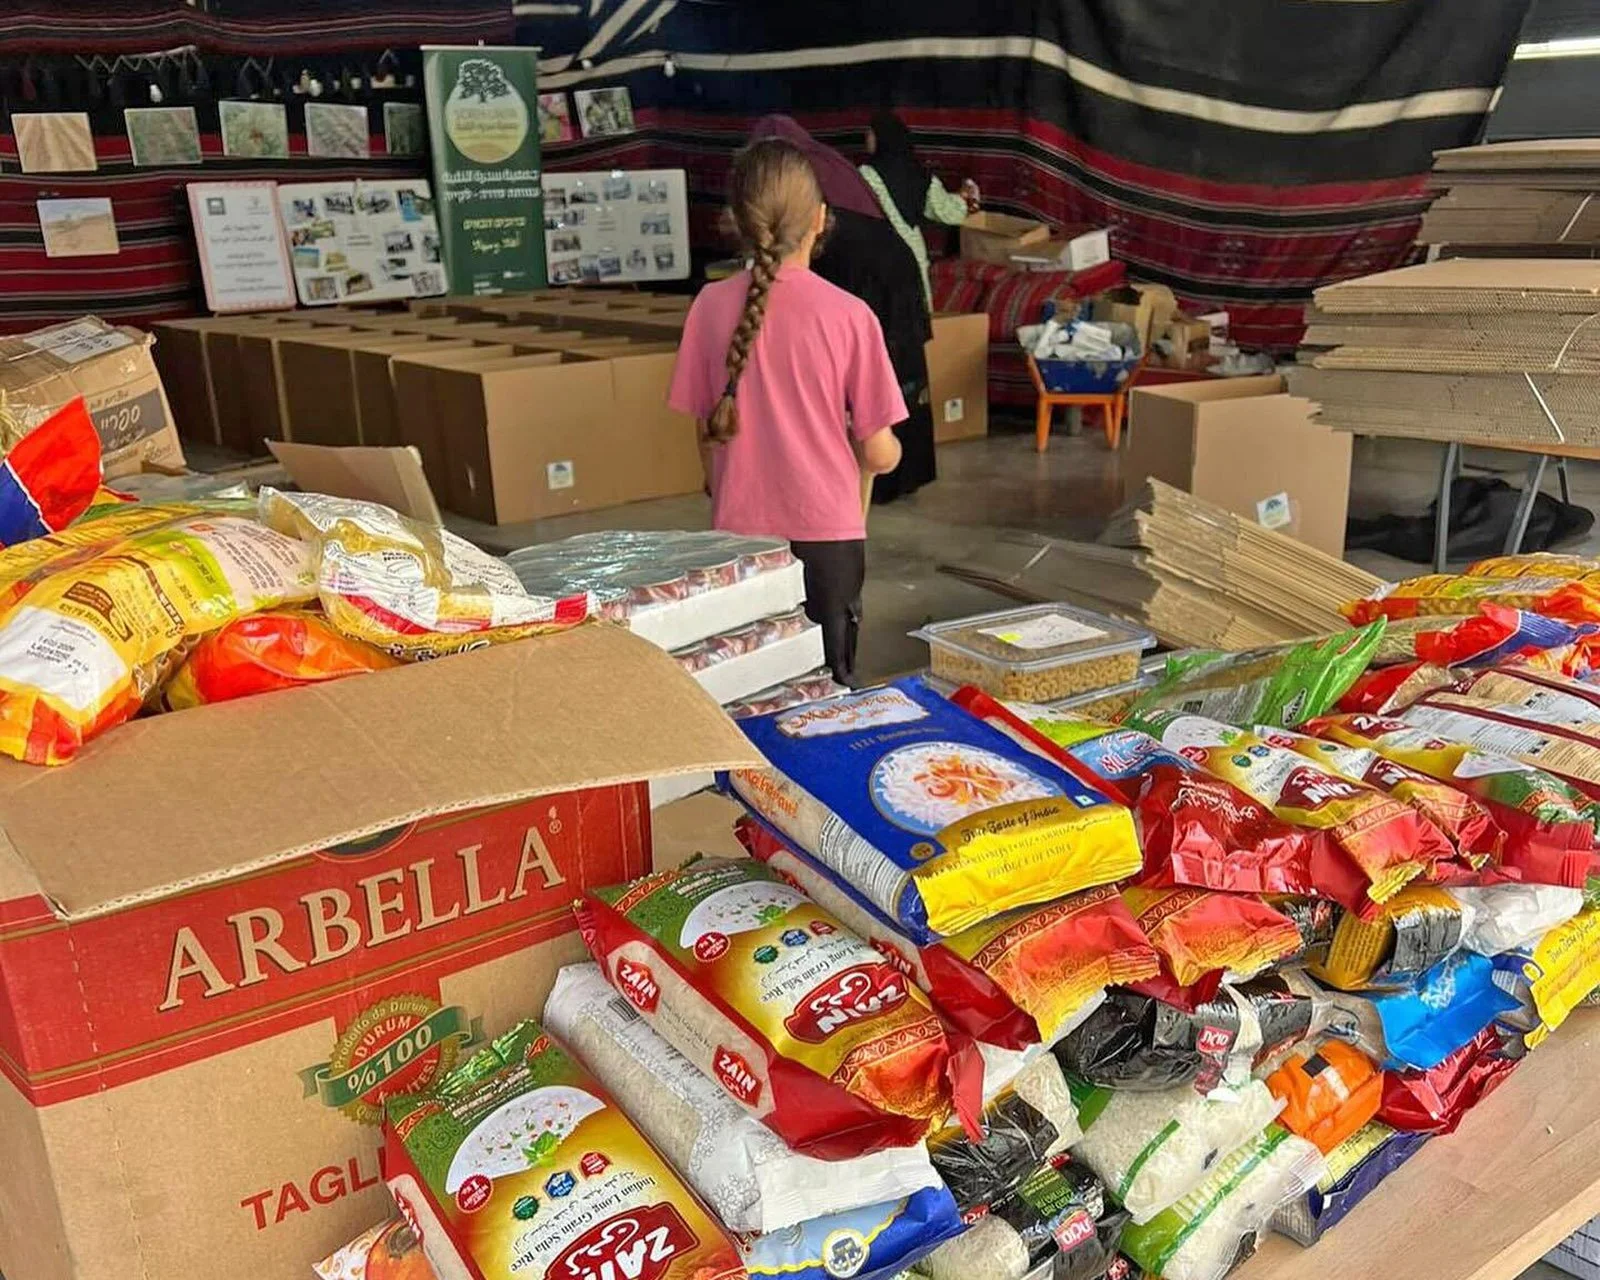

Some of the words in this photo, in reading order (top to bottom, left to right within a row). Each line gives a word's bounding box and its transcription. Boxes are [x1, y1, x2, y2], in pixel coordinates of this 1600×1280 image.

[157, 824, 567, 1012] ARBELLA
[827, 946, 855, 963] Long
[619, 963, 658, 1000] ZAIN
[801, 960, 831, 981] Grain
[816, 984, 906, 1034] ZAIN
[354, 1014, 413, 1059] DURUM
[347, 1024, 433, 1095] %100
[717, 1053, 758, 1093] ZAIN
[620, 1175, 657, 1197] Indian
[591, 1193, 622, 1214] Long
[561, 1211, 593, 1235] Grain
[534, 1231, 561, 1254] Sella
[582, 1224, 676, 1280] ZAI
[509, 1251, 536, 1273] Rice
